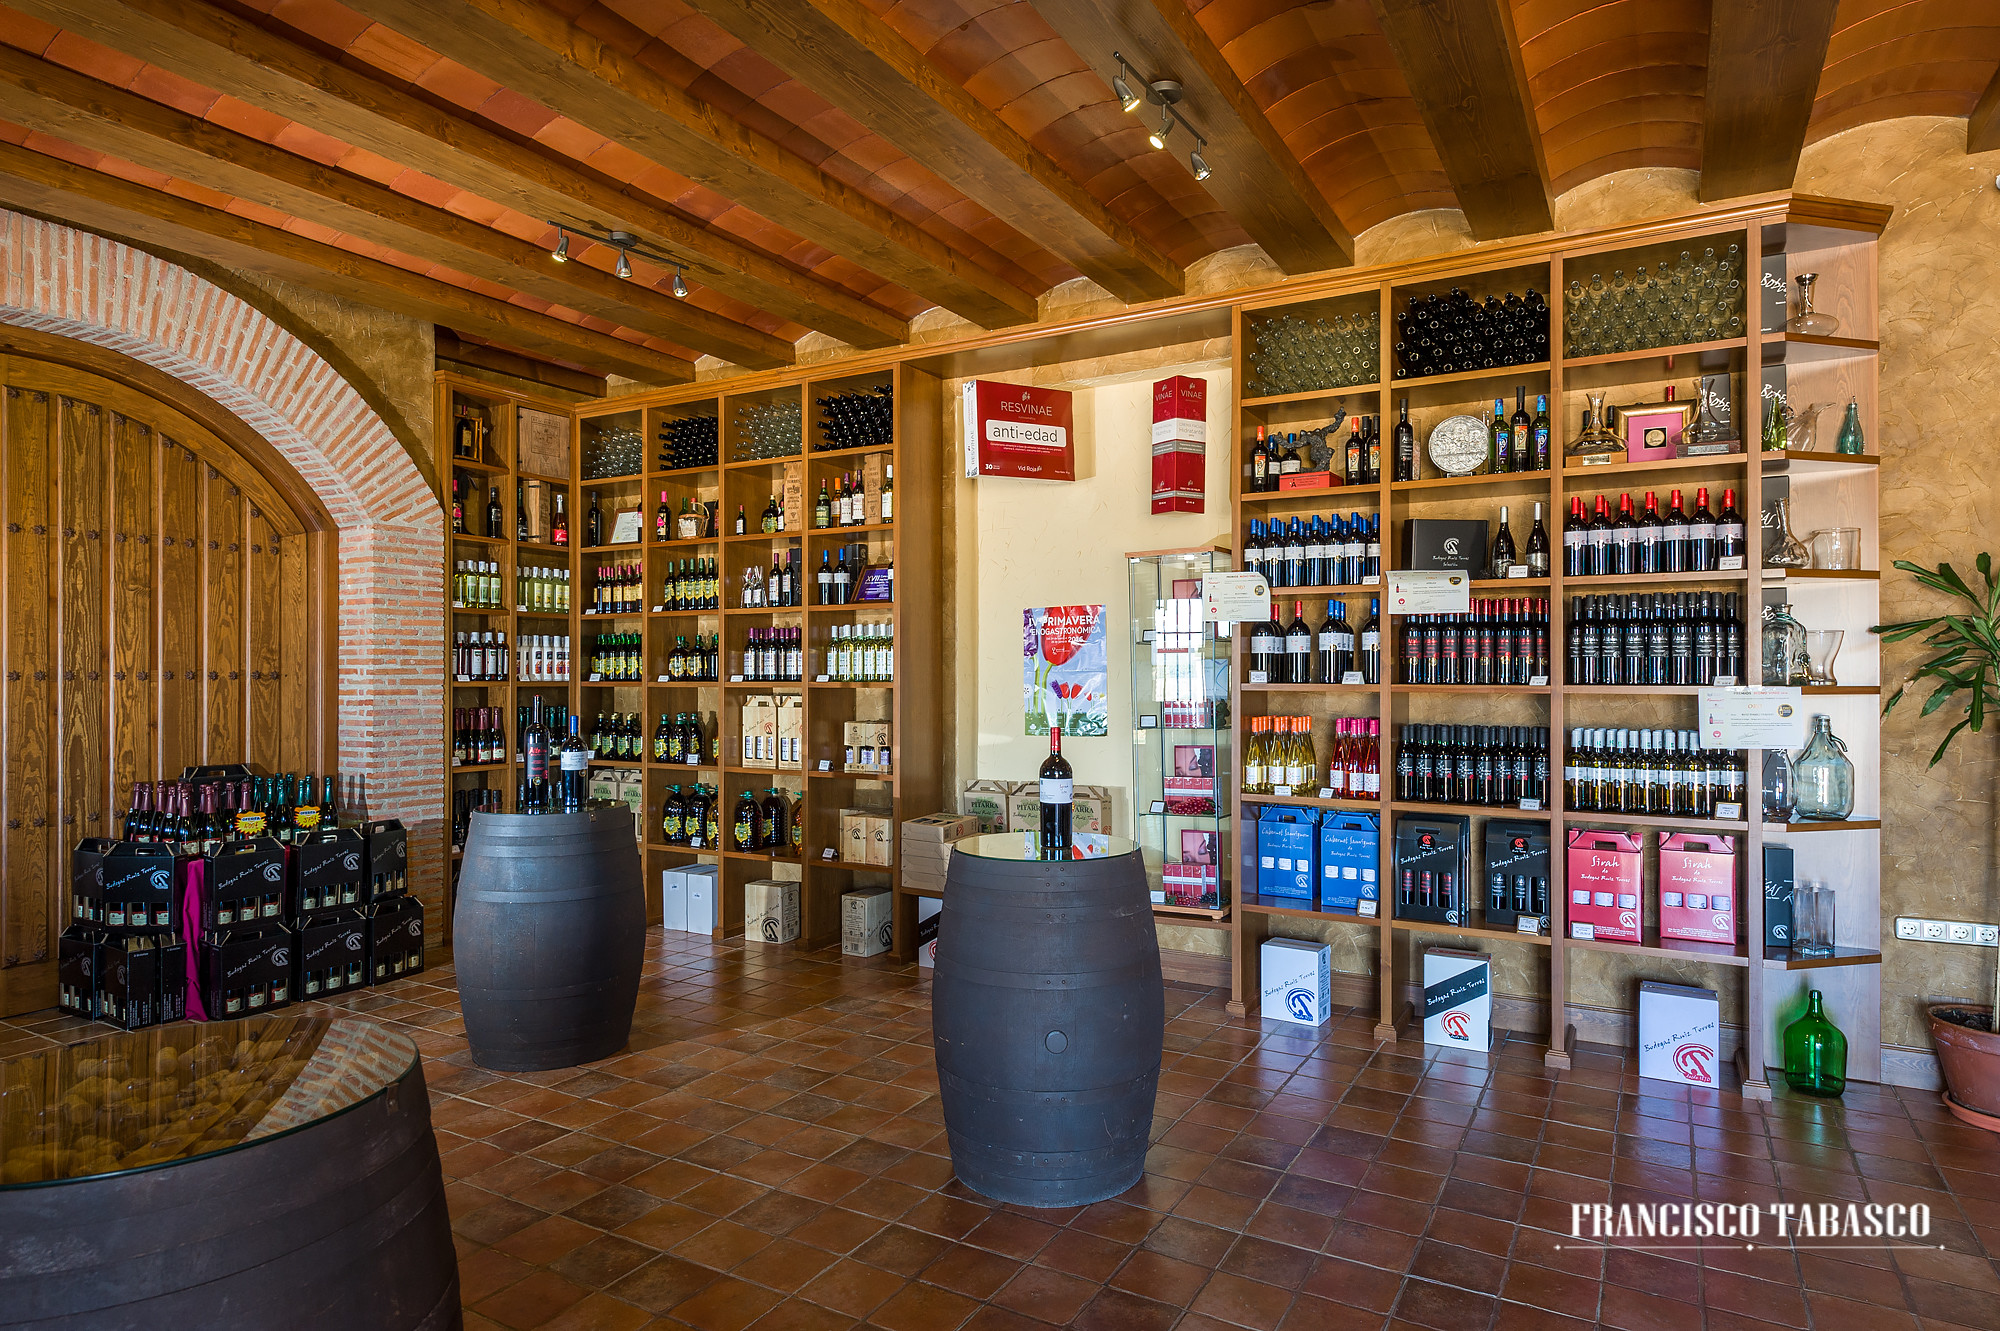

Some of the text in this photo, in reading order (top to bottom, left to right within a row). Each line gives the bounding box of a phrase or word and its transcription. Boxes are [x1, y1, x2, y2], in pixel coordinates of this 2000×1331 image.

[1155, 390, 1173, 401] VINAE
[1180, 389, 1203, 400] VINAE
[1000, 400, 1053, 417] RESVINAE
[993, 425, 1058, 443] anti-edad
[1178, 427, 1204, 435] Hidratante
[1029, 615, 1101, 627] IV PRIMAVERA
[1261, 827, 1310, 840] Cabernet Sauvignon
[1325, 834, 1376, 848] Cabernet Sauvignon
[303, 848, 350, 877] Bodegas Ruiz Torres
[1400, 844, 1454, 864] Bodegas Ruiz Torres
[1490, 848, 1548, 869] Bodegas Ruiz Torres
[1591, 855, 1620, 868] Sirah
[1682, 856, 1713, 869] Sirah
[106, 865, 157, 890] Bodegas Ruiz Torres
[218, 859, 270, 890] Bodegas Ruiz Torres
[1580, 873, 1632, 883] Bodegas Ruiz Torres
[1671, 875, 1724, 885] Bodegas Ruiz Torres
[306, 929, 351, 960] Bodegas Ruiz Torres
[226, 944, 277, 978] Bodegas Ruiz Torres
[1264, 970, 1316, 997] Bodegas Ruiz Torres
[1426, 978, 1486, 1006] Bodegas Ruiz Torres
[1644, 1022, 1715, 1053] Bodegas Ruiz Torres
